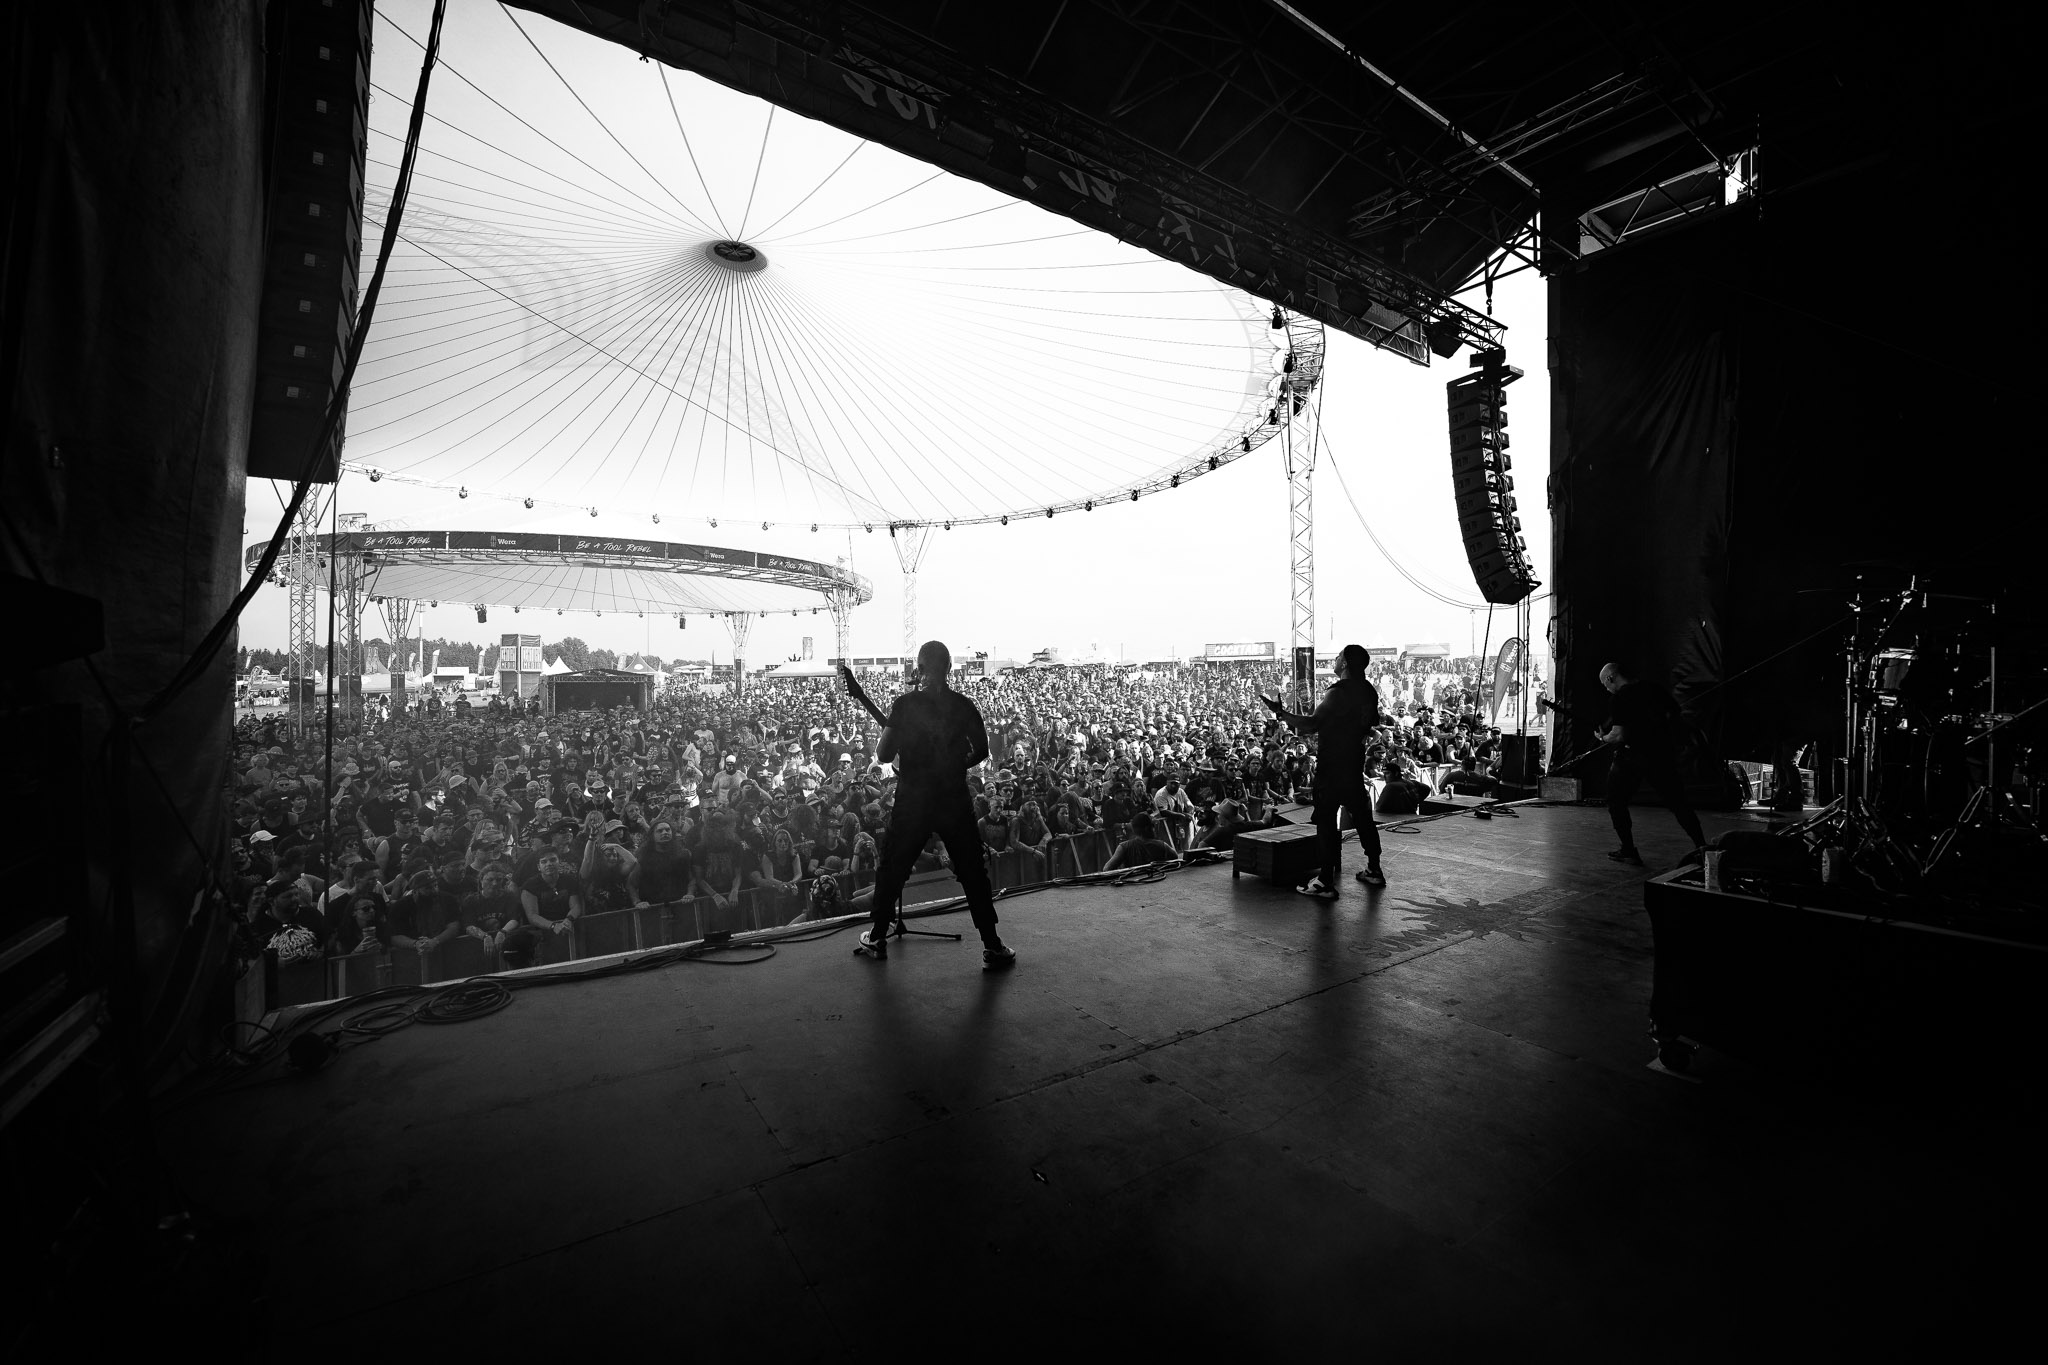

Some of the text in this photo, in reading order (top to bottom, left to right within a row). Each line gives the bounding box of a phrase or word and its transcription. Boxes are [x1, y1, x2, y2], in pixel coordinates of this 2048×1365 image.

[385, 535, 404, 546] TOOL
[405, 535, 431, 546] REBEL
[603, 541, 623, 551] TOOL
[625, 543, 652, 553] REBEL
[709, 552, 725, 560] Wera
[1214, 643, 1267, 656] COCKTAILS
